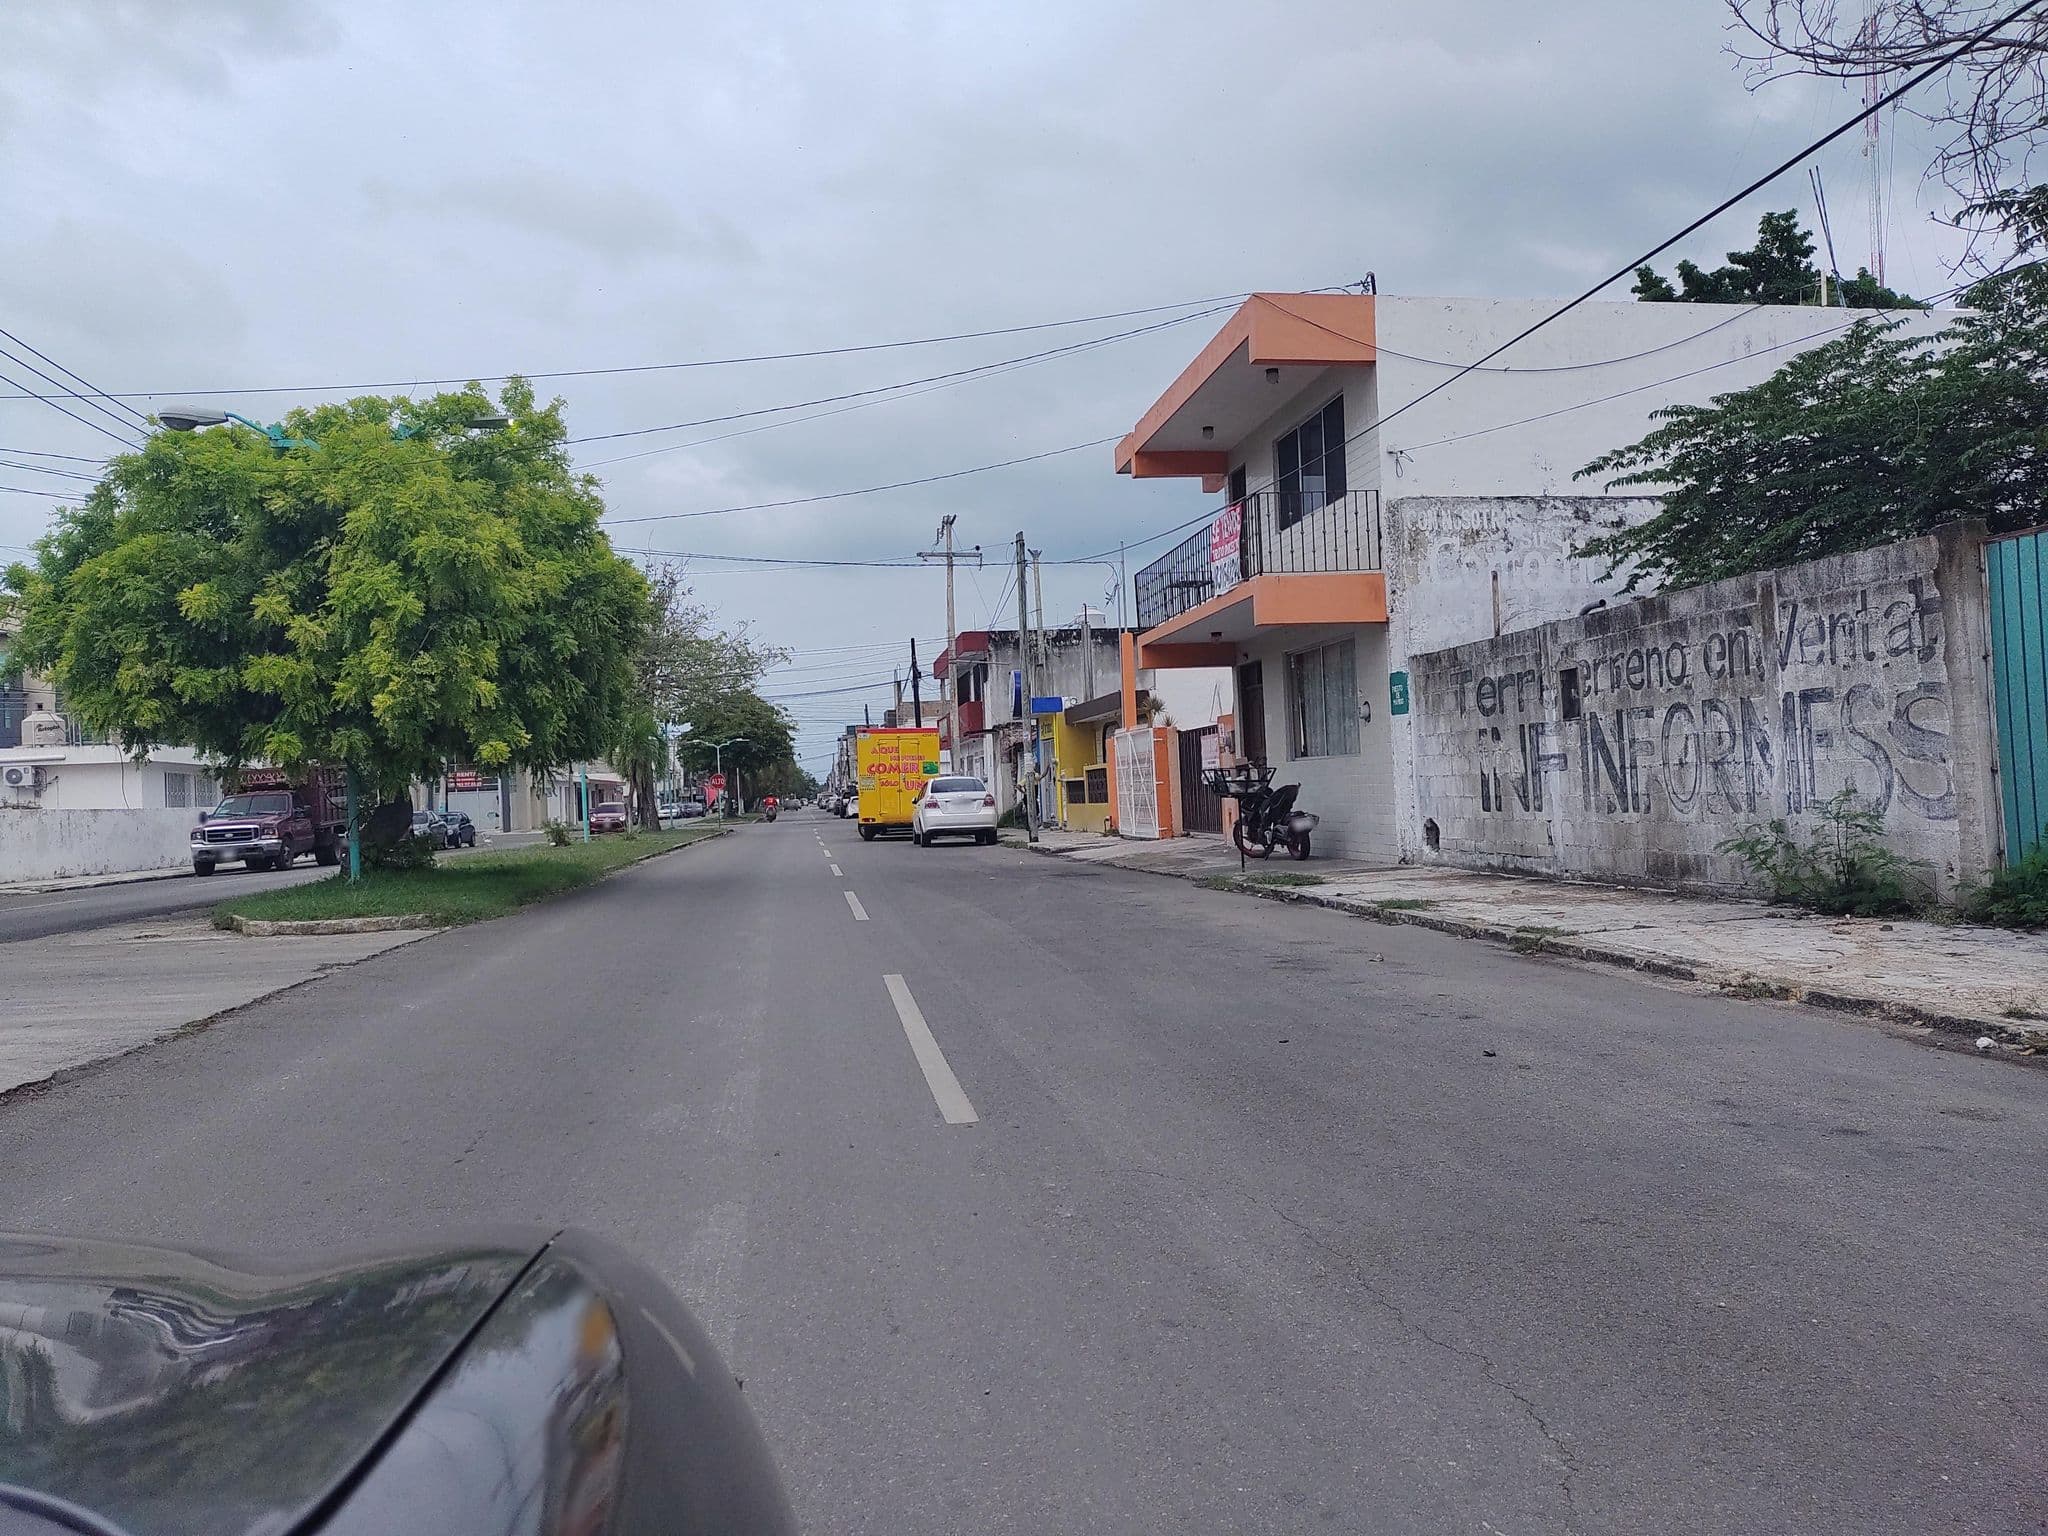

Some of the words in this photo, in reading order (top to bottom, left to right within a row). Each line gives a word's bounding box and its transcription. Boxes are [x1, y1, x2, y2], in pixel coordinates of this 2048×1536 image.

[1703, 630, 1751, 681] en
[867, 762, 919, 775] COMER
[904, 780, 925, 791] UN
